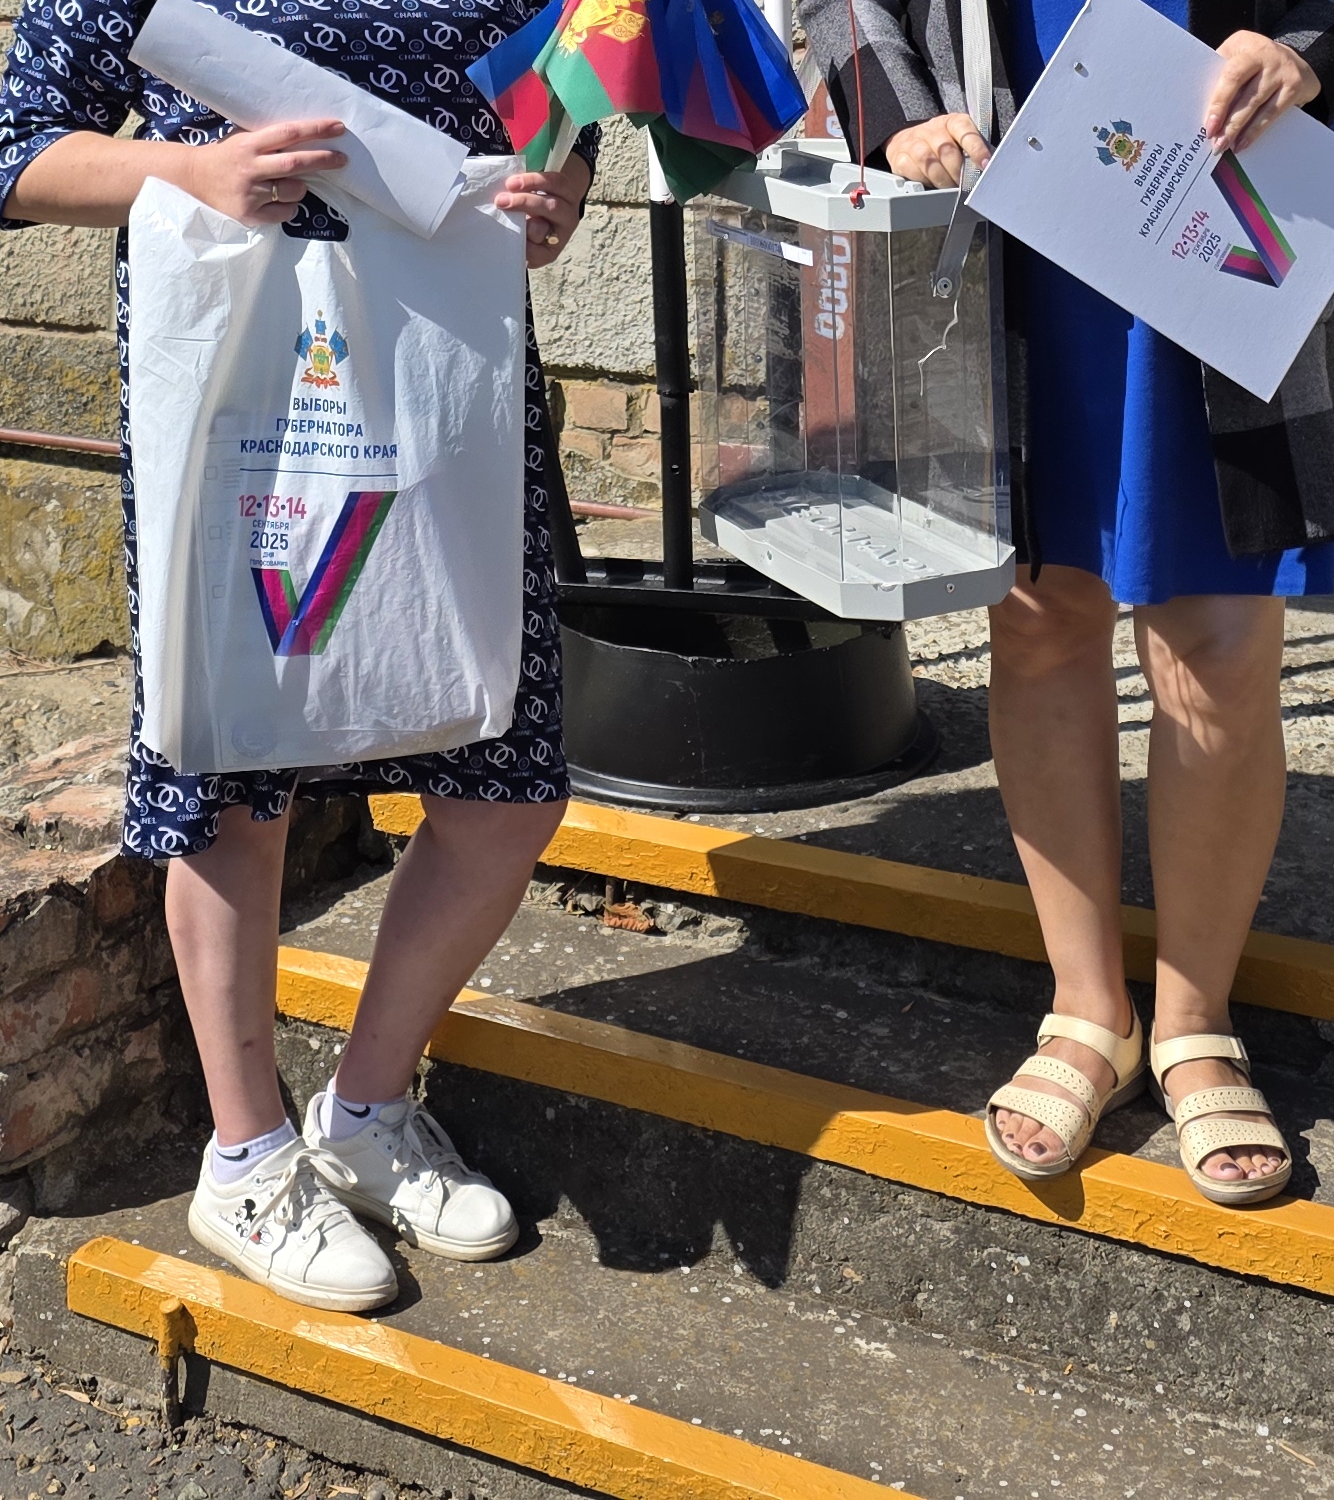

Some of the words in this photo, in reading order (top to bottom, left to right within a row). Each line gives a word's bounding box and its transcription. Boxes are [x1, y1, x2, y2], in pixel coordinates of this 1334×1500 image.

[272, 14, 310, 24] CHANEL
[71, 32, 100, 44] CHANEL
[1134, 143, 1165, 188] ВЫБОРЫ
[1139, 142, 1184, 207] ГУБЕРНАТОРА
[1139, 153, 1194, 238] КРАСНОДАРСКОГО
[1198, 232, 1222, 263] 2025
[293, 397, 347, 415] ВЫБОРЫ
[276, 418, 364, 438] ГУБЕРНАТОРА
[240, 439, 359, 460] КРАСНОДАРСКОГО
[363, 444, 398, 459] КРАЯ
[252, 519, 290, 531] СЕНТЯБРЯ
[250, 530, 289, 551] 2025
